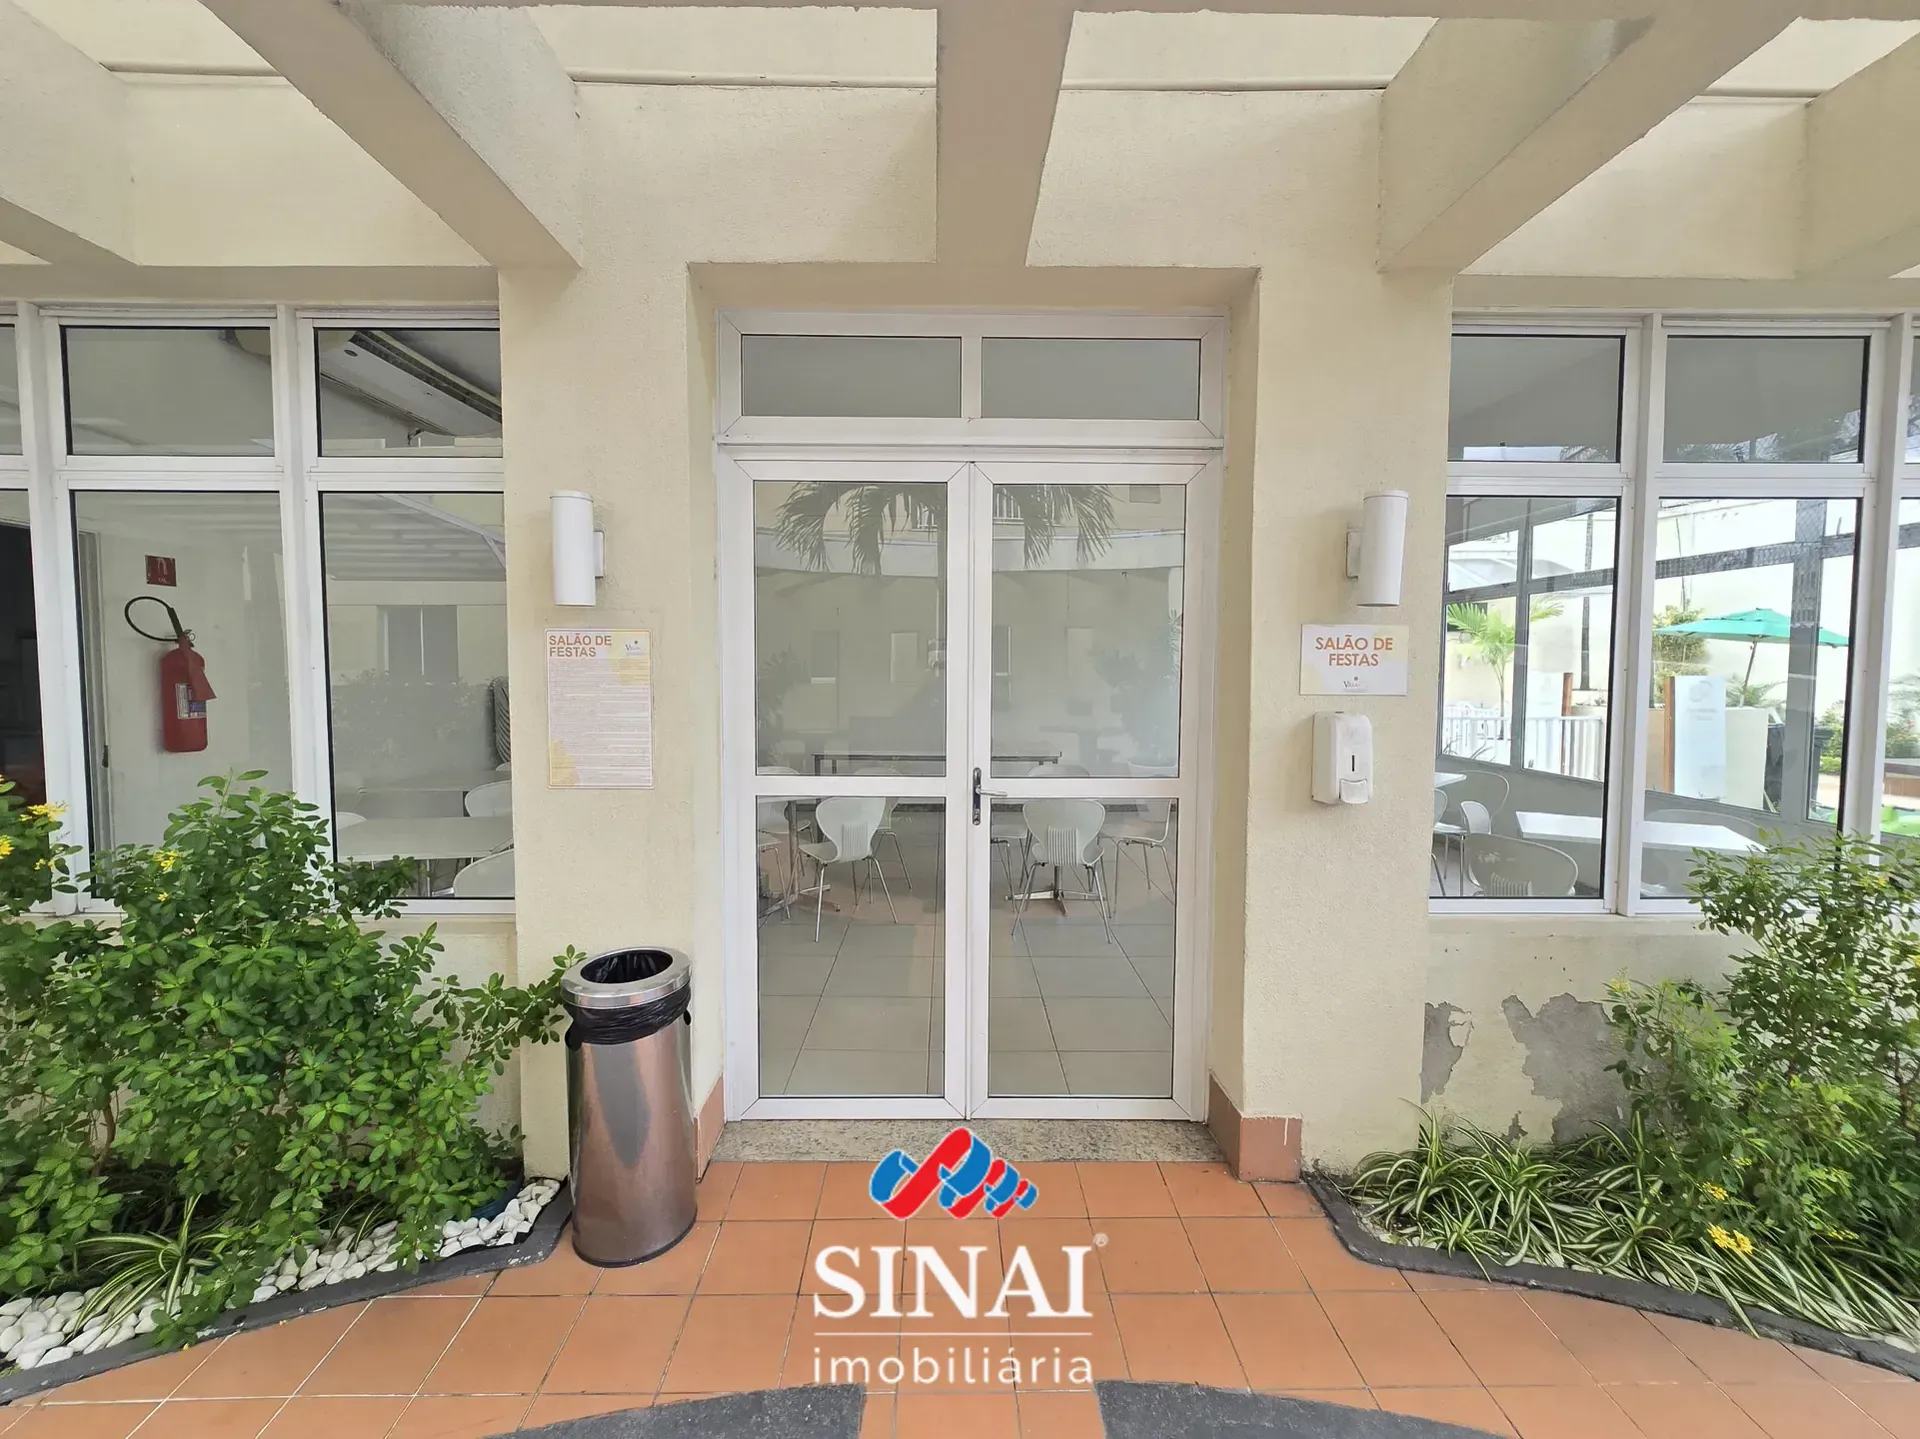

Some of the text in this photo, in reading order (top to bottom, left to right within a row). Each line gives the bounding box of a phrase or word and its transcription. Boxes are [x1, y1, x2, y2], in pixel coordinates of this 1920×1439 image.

[549, 633, 612, 646] SALÃO DE
[1315, 634, 1393, 650] SALÃO DE
[549, 647, 597, 657] FESTAS
[1328, 653, 1379, 666] FESTAS
